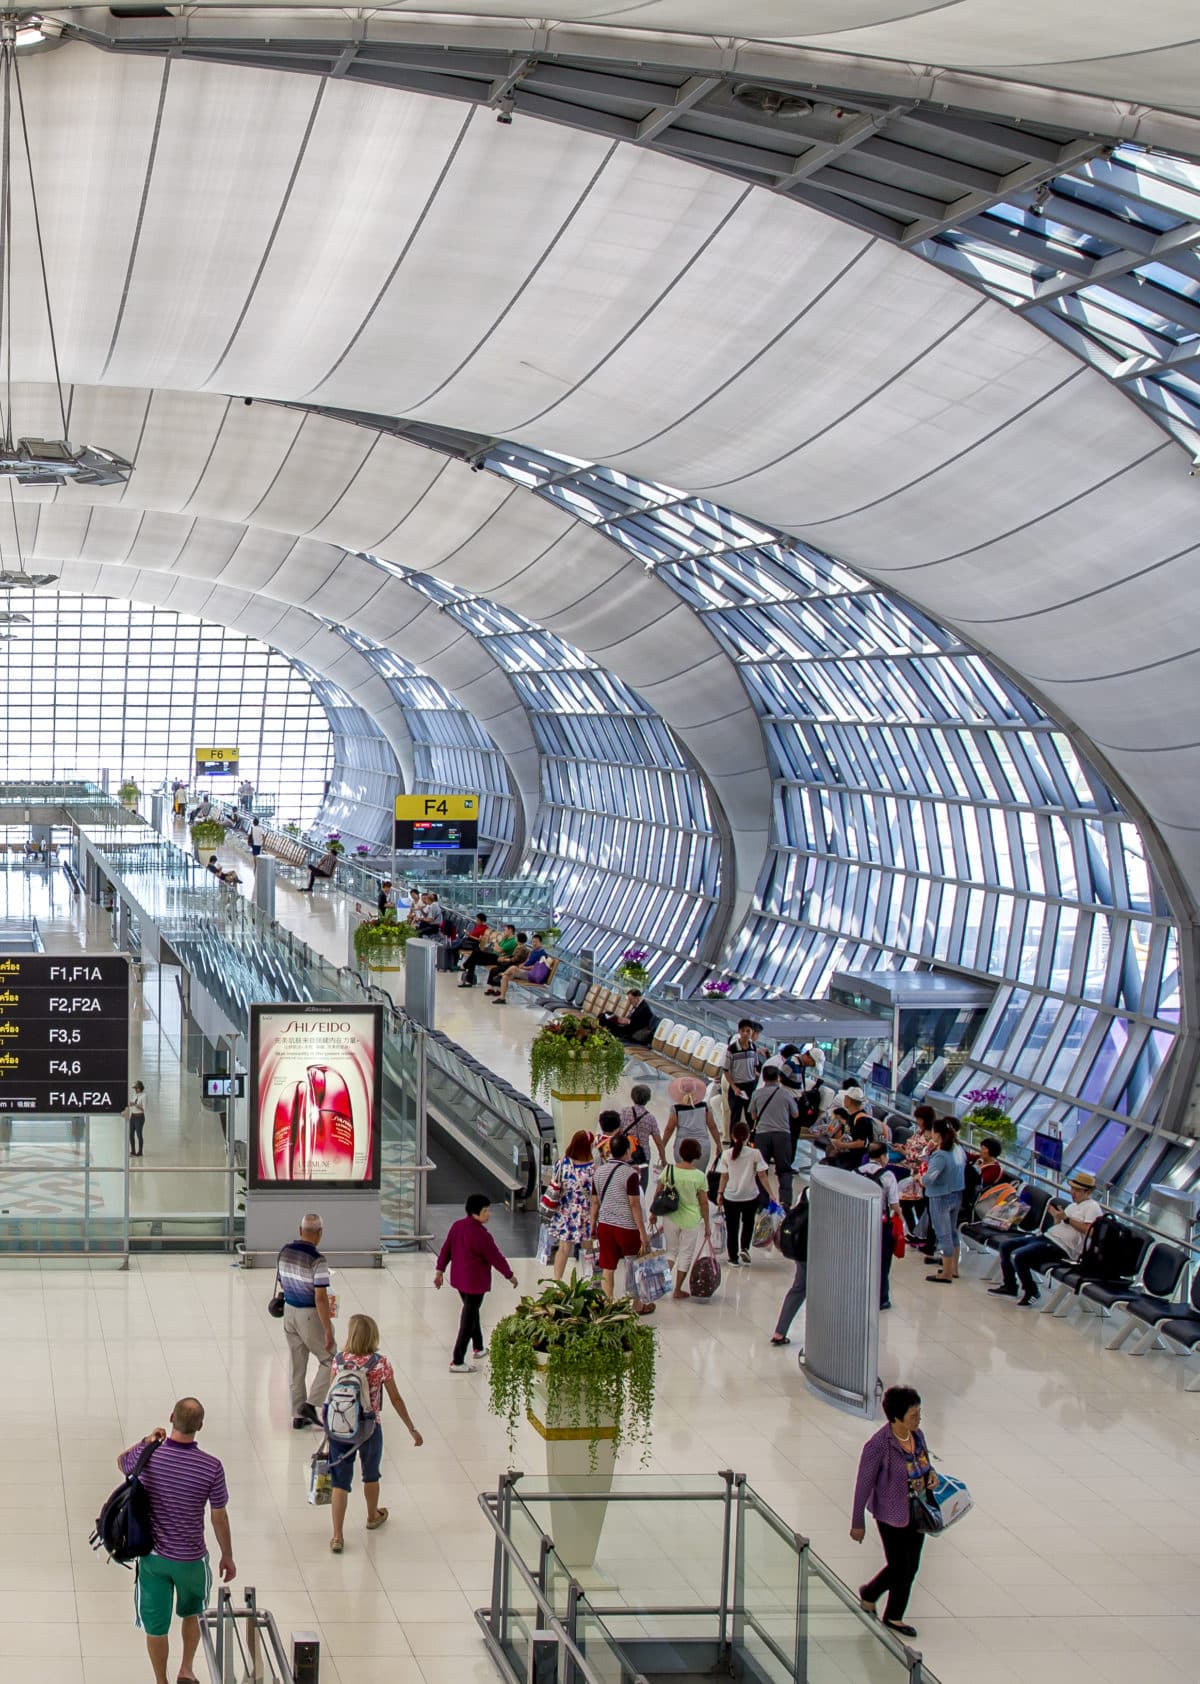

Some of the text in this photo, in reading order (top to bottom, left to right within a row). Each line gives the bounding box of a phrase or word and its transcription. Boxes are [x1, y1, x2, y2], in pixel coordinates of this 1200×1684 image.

[210, 750, 224, 759] F6
[424, 799, 448, 815] F4
[50, 966, 102, 982] F1,F1A
[49, 998, 101, 1013] F2,F2A
[280, 1020, 351, 1033] SHISEIDO
[49, 1029, 81, 1044] F3,5
[49, 1060, 81, 1076] F4,6
[49, 1092, 112, 1108] F1A,F2A
